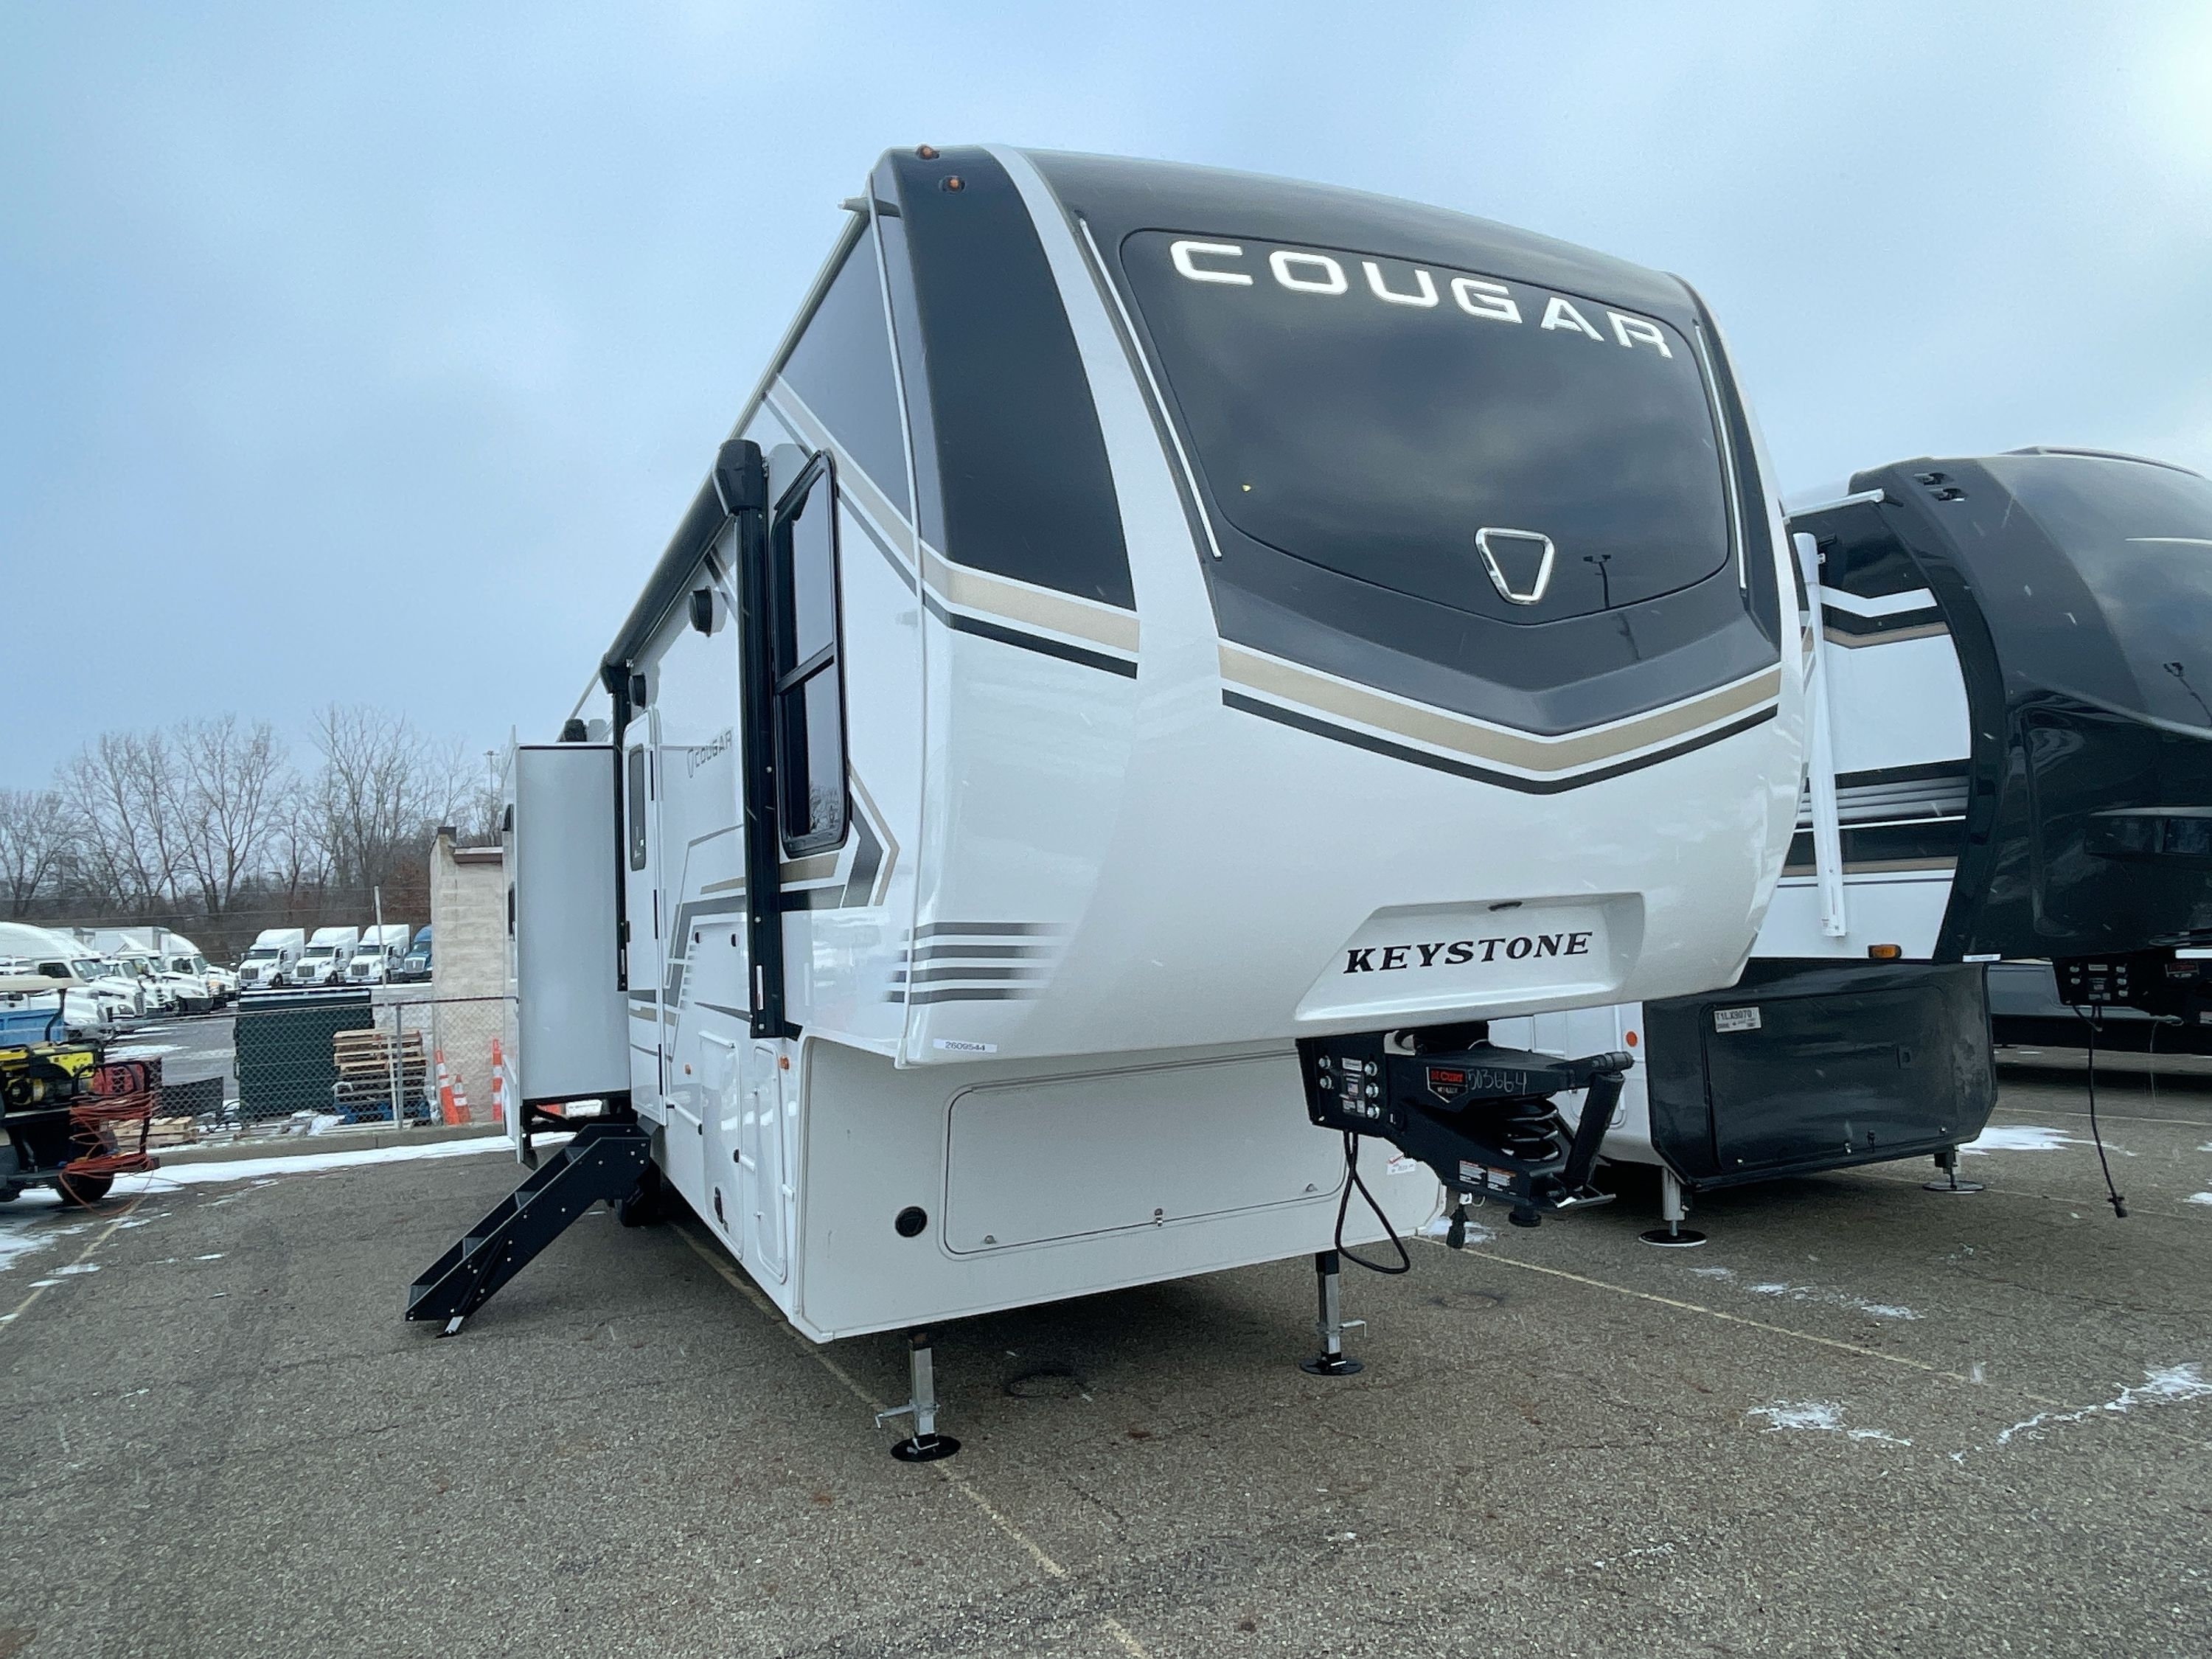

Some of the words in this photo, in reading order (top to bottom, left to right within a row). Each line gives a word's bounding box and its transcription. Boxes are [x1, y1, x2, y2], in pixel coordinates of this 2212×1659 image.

[1169, 240, 1673, 358] COUGAR
[695, 728, 733, 768] COUGAR
[1343, 931, 1593, 974] KEYSTONE
[1467, 1068, 1528, 1096] 503664
